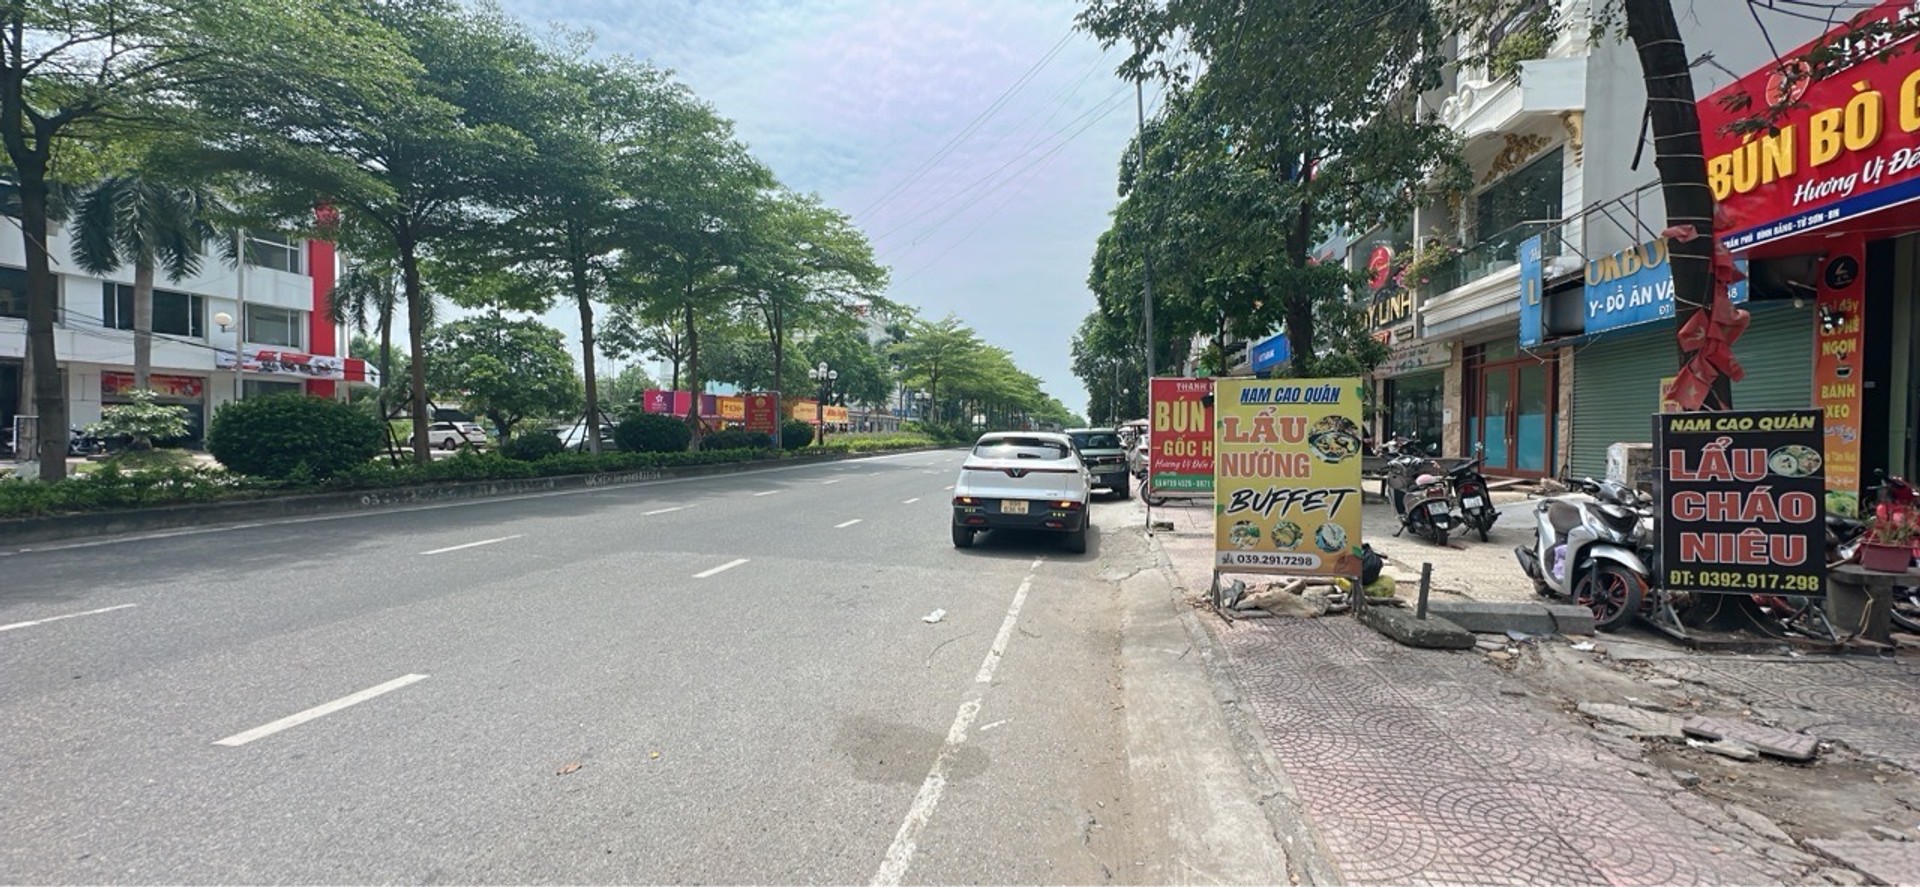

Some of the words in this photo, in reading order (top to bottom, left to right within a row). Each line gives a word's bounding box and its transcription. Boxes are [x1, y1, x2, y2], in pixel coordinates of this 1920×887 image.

[1707, 124, 1796, 201] BÚN
[1810, 80, 1883, 167] BÒ
[1793, 172, 1858, 206] Hương
[1862, 156, 1885, 184] Vị
[1606, 284, 1625, 313] ĐỒ
[1629, 286, 1652, 310] ĂN
[1240, 387, 1271, 402] NAM
[1275, 387, 1301, 402] CAO
[1304, 384, 1340, 403] QUÁN
[1155, 396, 1205, 432] BÚN
[1223, 407, 1308, 444] LẨU
[1670, 418, 1712, 431] NAM
[1716, 417, 1754, 431] CAO
[1758, 413, 1815, 431] QUÁN
[1163, 434, 1197, 457] GỐC
[1669, 436, 1769, 482] LẨU
[1221, 448, 1311, 478] NƯỚNG
[1227, 487, 1358, 518] BUFFET
[1671, 485, 1817, 523] CHÁO
[1237, 553, 1313, 567] 039.291.7298
[1680, 527, 1807, 566] NIÊU
[1670, 570, 1695, 586] ĐT:
[1700, 571, 1819, 591] 0392.917.298
